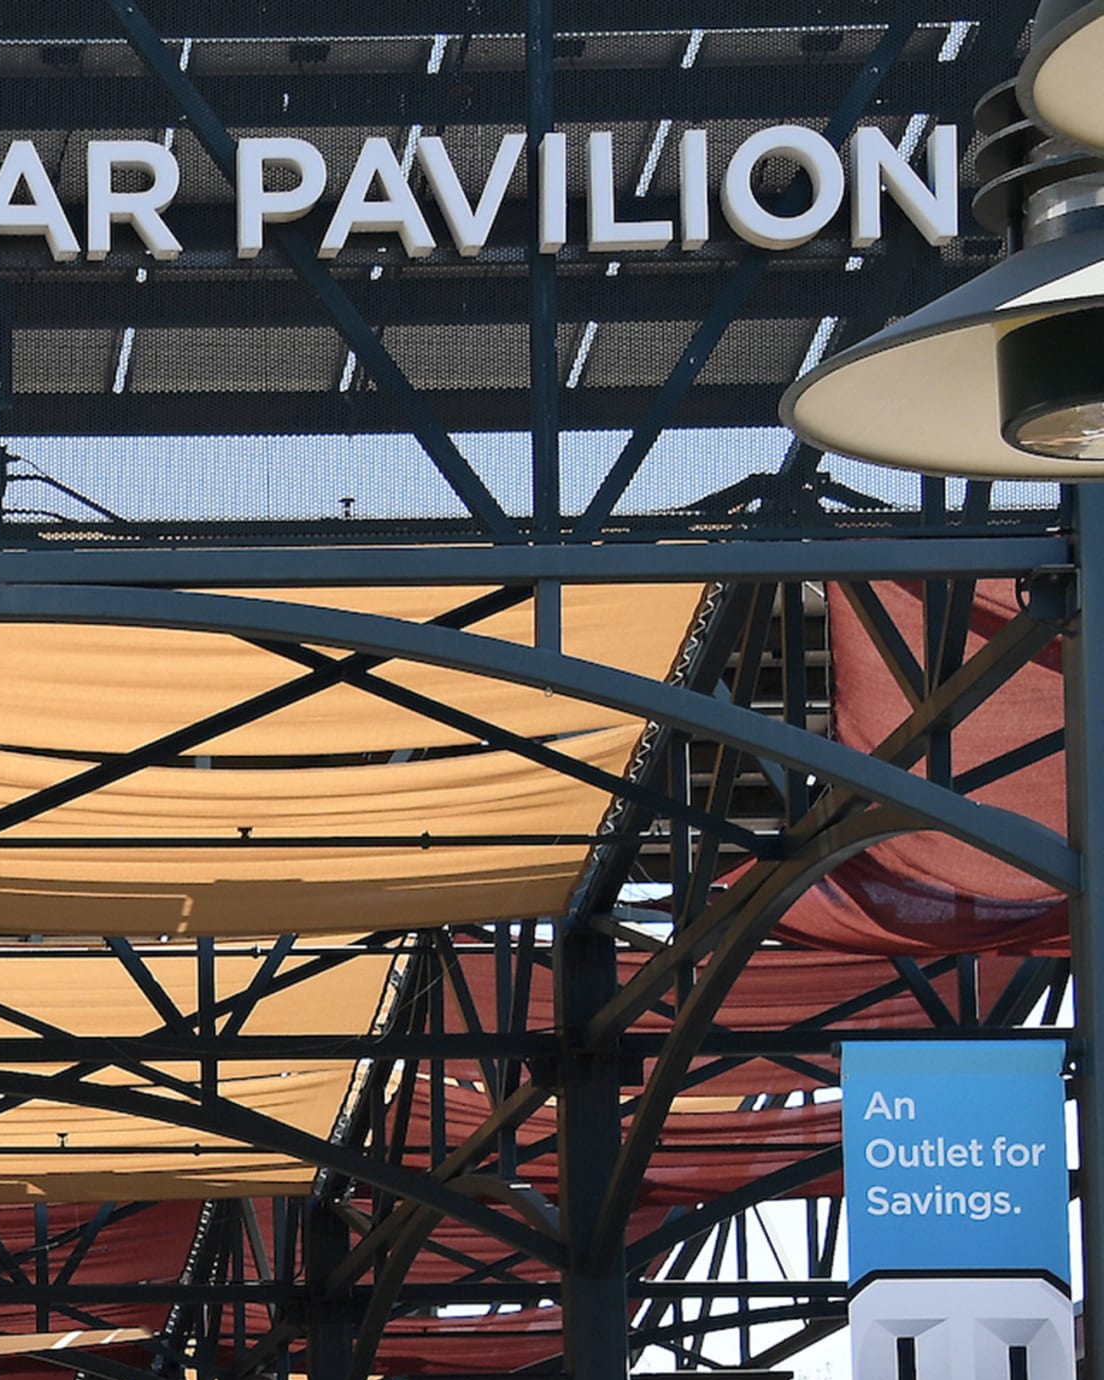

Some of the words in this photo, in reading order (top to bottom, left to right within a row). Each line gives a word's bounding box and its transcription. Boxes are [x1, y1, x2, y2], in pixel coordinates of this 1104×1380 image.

[236, 124, 959, 257] PAVILION
[864, 1091, 916, 1120] An
[865, 1137, 984, 1168] Outlet
[992, 1137, 1046, 1167] for
[867, 1185, 1022, 1220] Savings.
